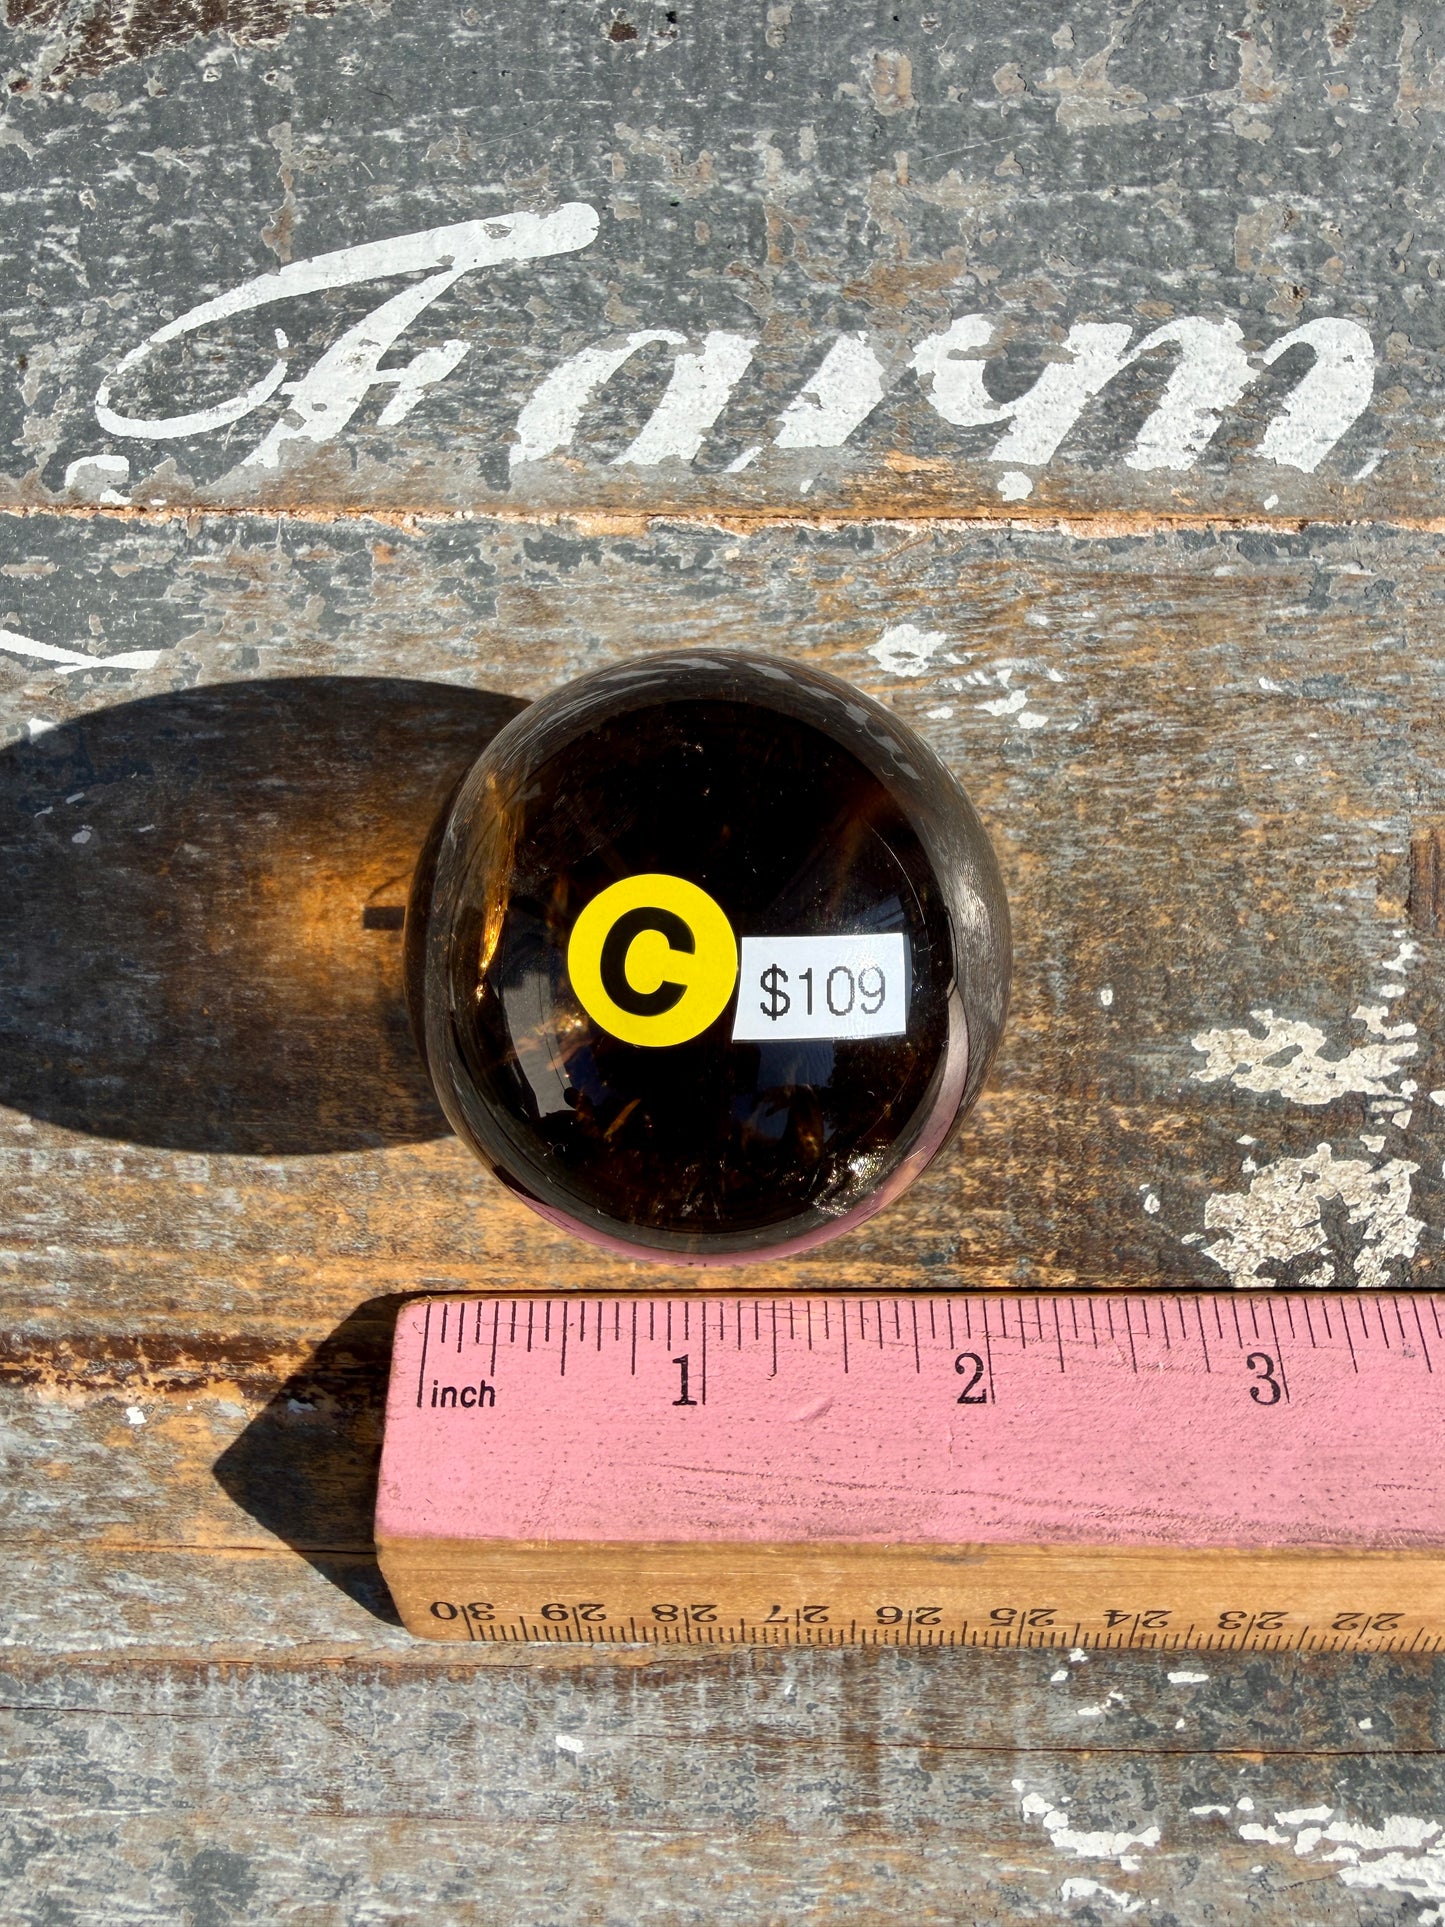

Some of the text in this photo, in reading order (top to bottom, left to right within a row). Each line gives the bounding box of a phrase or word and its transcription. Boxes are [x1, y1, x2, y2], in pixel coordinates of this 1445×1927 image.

[599, 906, 696, 1018] C
[760, 963, 886, 1021] $109
[431, 1352, 1281, 1408] inch 1 2 3
[430, 1601, 1406, 1632] 30 29 28 27 26 25 24 23 22
